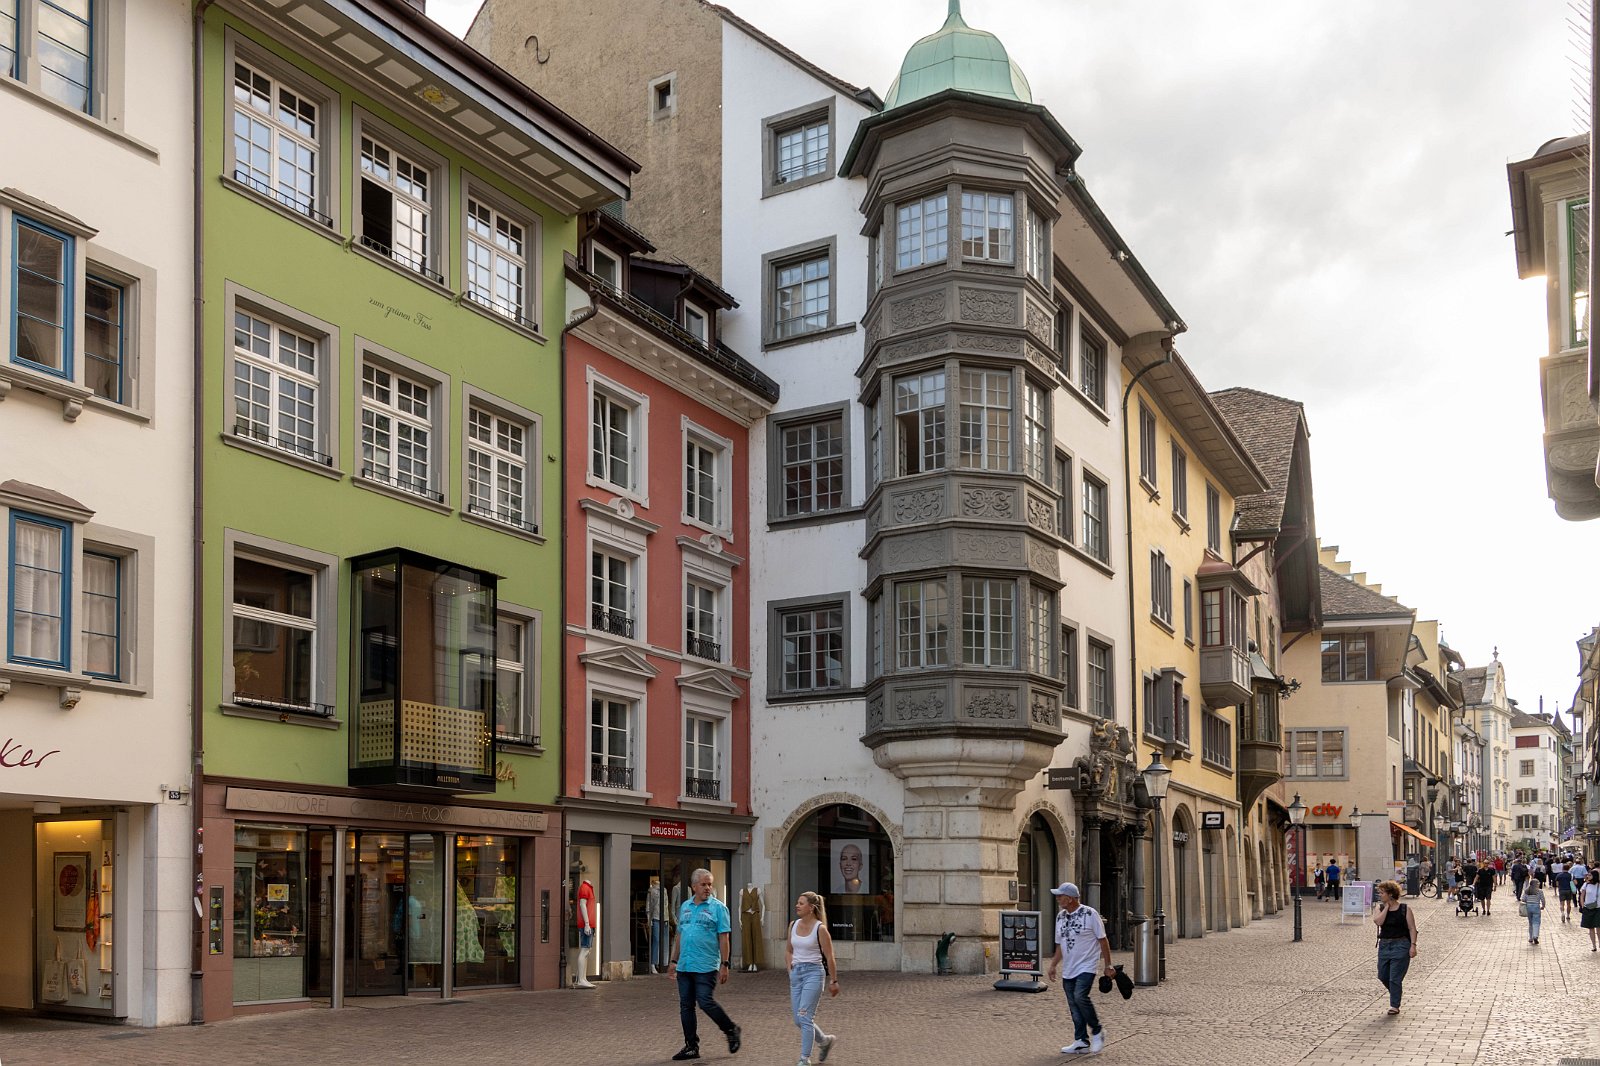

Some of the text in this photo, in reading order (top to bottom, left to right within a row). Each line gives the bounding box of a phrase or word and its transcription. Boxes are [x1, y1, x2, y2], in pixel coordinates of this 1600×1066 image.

[369, 297, 385, 309] zum
[384, 306, 411, 321] grünen
[238, 792, 329, 813] KONDITOREI
[1311, 802, 1343, 819] city
[478, 811, 542, 830] CONFISERIE
[651, 826, 685, 837] DRUGSTORE
